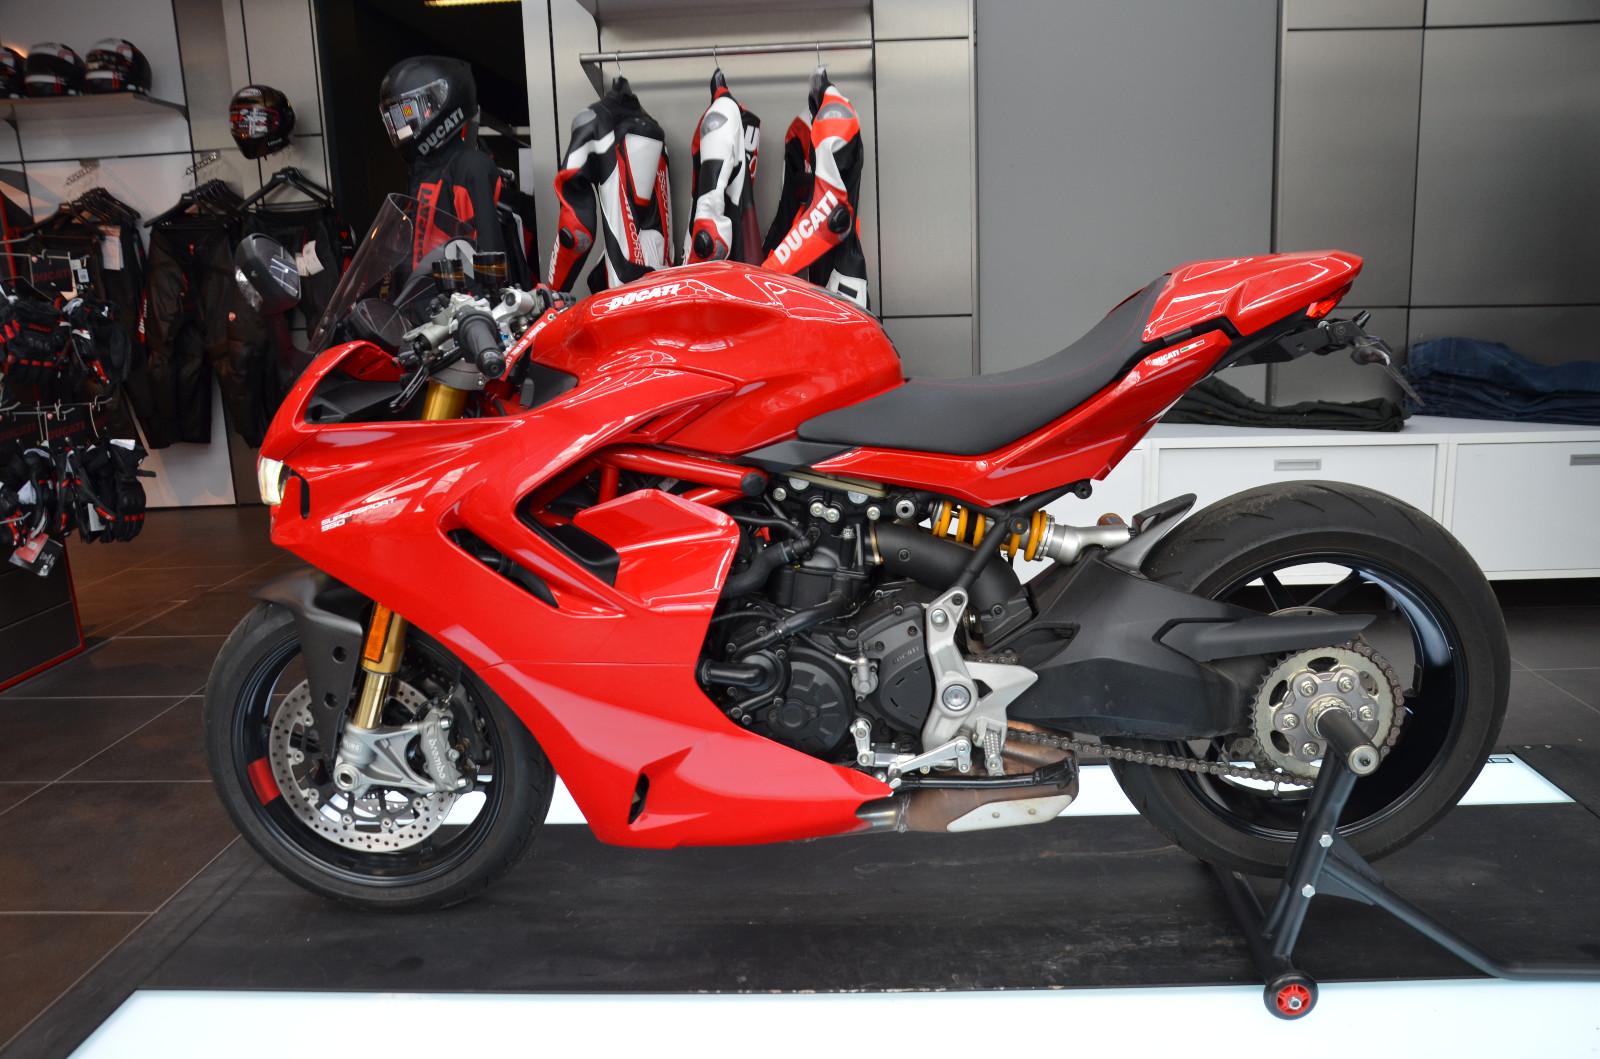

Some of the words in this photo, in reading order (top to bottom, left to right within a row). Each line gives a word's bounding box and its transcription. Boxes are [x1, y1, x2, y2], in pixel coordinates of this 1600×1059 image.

[417, 107, 464, 156] DUCATI
[629, 222, 645, 266] CORSE
[773, 190, 839, 265] DUCATI
[606, 283, 680, 311] DUCATI
[321, 496, 397, 526] SUPERSPORT
[429, 738, 446, 780] brembo
